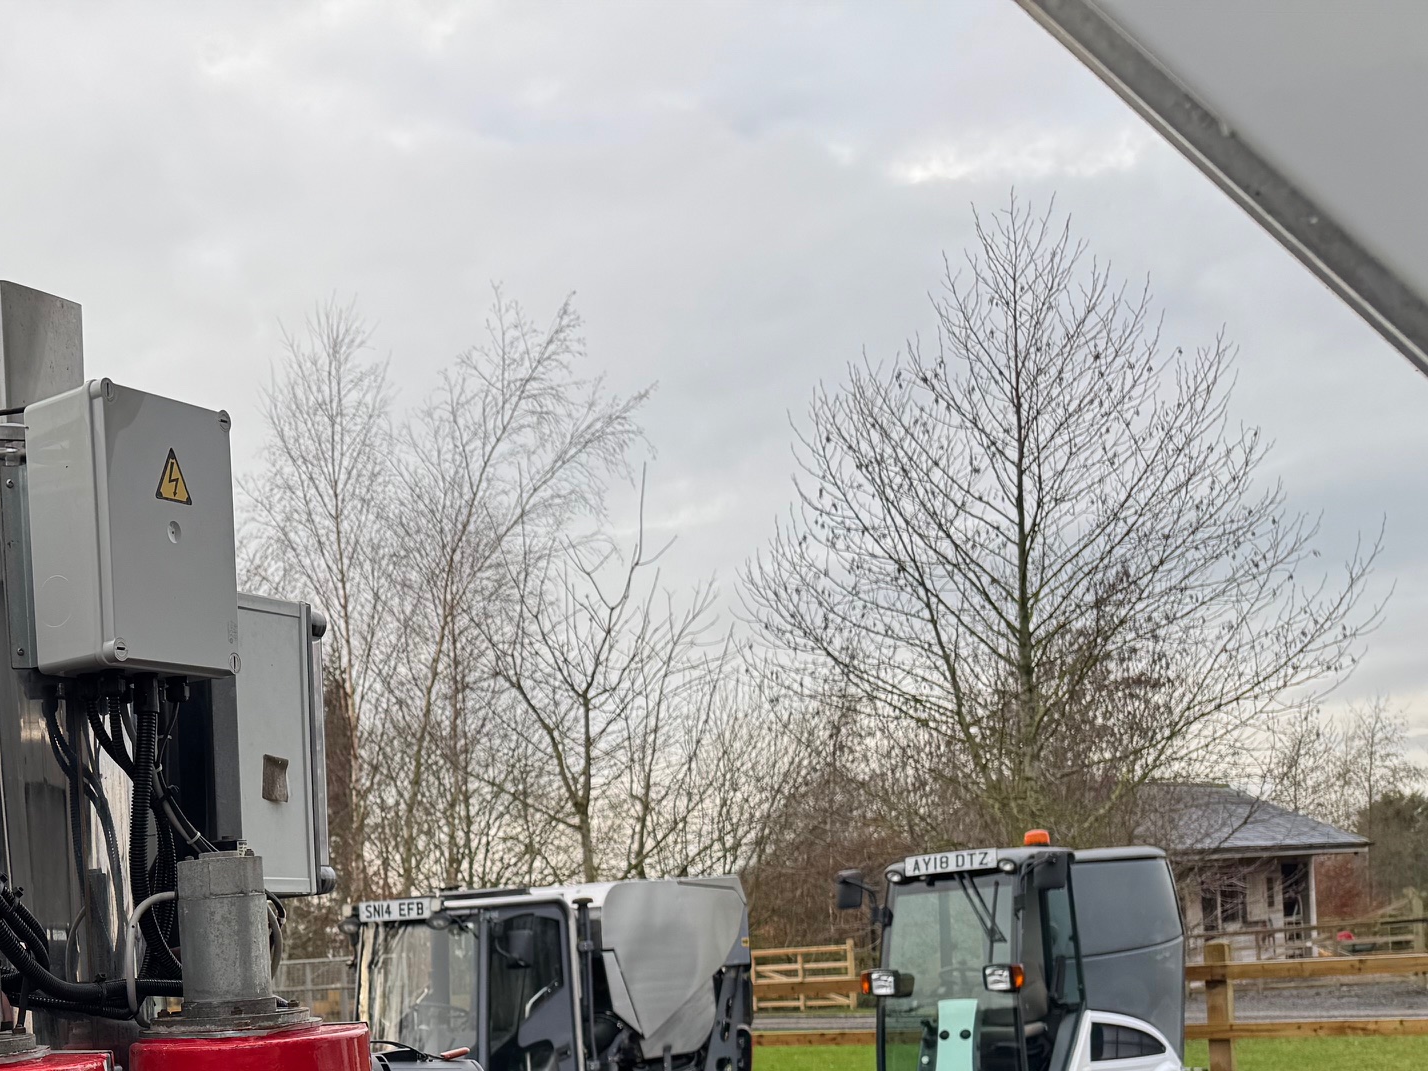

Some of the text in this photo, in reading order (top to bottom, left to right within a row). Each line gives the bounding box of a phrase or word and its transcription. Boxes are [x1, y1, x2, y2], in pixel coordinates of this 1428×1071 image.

[912, 851, 989, 874] AY18 DTZ
[365, 901, 424, 919] SN14 EFB
